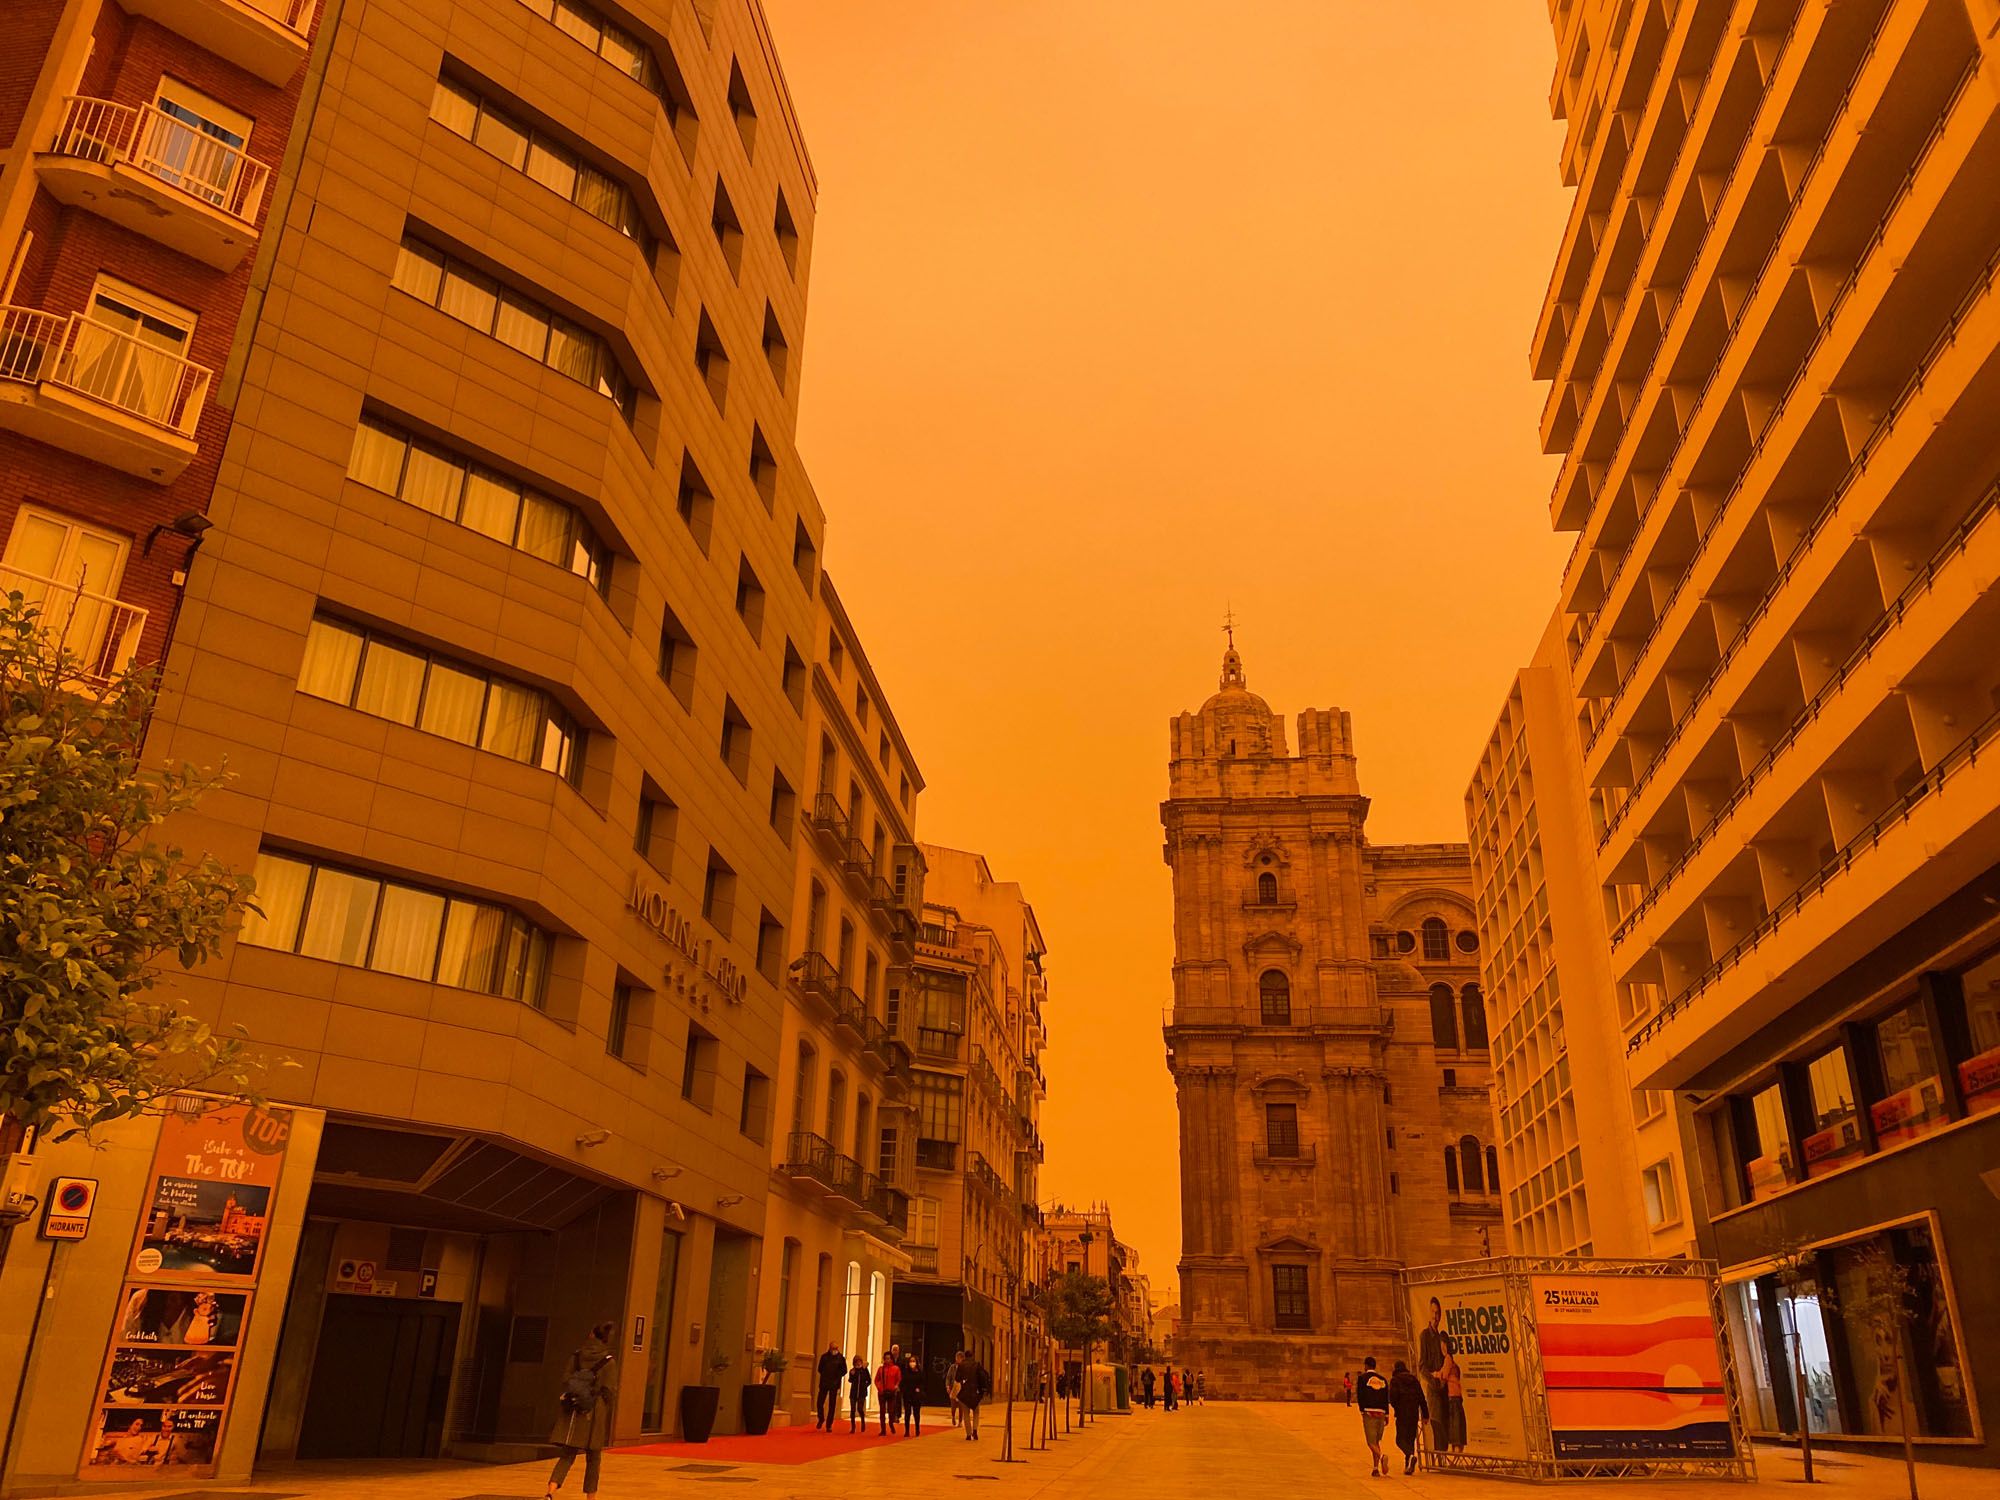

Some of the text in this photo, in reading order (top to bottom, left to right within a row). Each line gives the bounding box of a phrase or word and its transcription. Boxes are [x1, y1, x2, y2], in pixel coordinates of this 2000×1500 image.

[632, 872, 699, 965] MOLINA
[249, 1110, 288, 1146] TOP
[186, 1154, 215, 1175] The
[49, 1222, 84, 1232] HIDRANTE
[422, 1274, 435, 1292] P
[1544, 1290, 1560, 1304] 25
[1446, 1301, 1507, 1335] HÉROES
[1448, 1334, 1510, 1354] DE BARRIO
